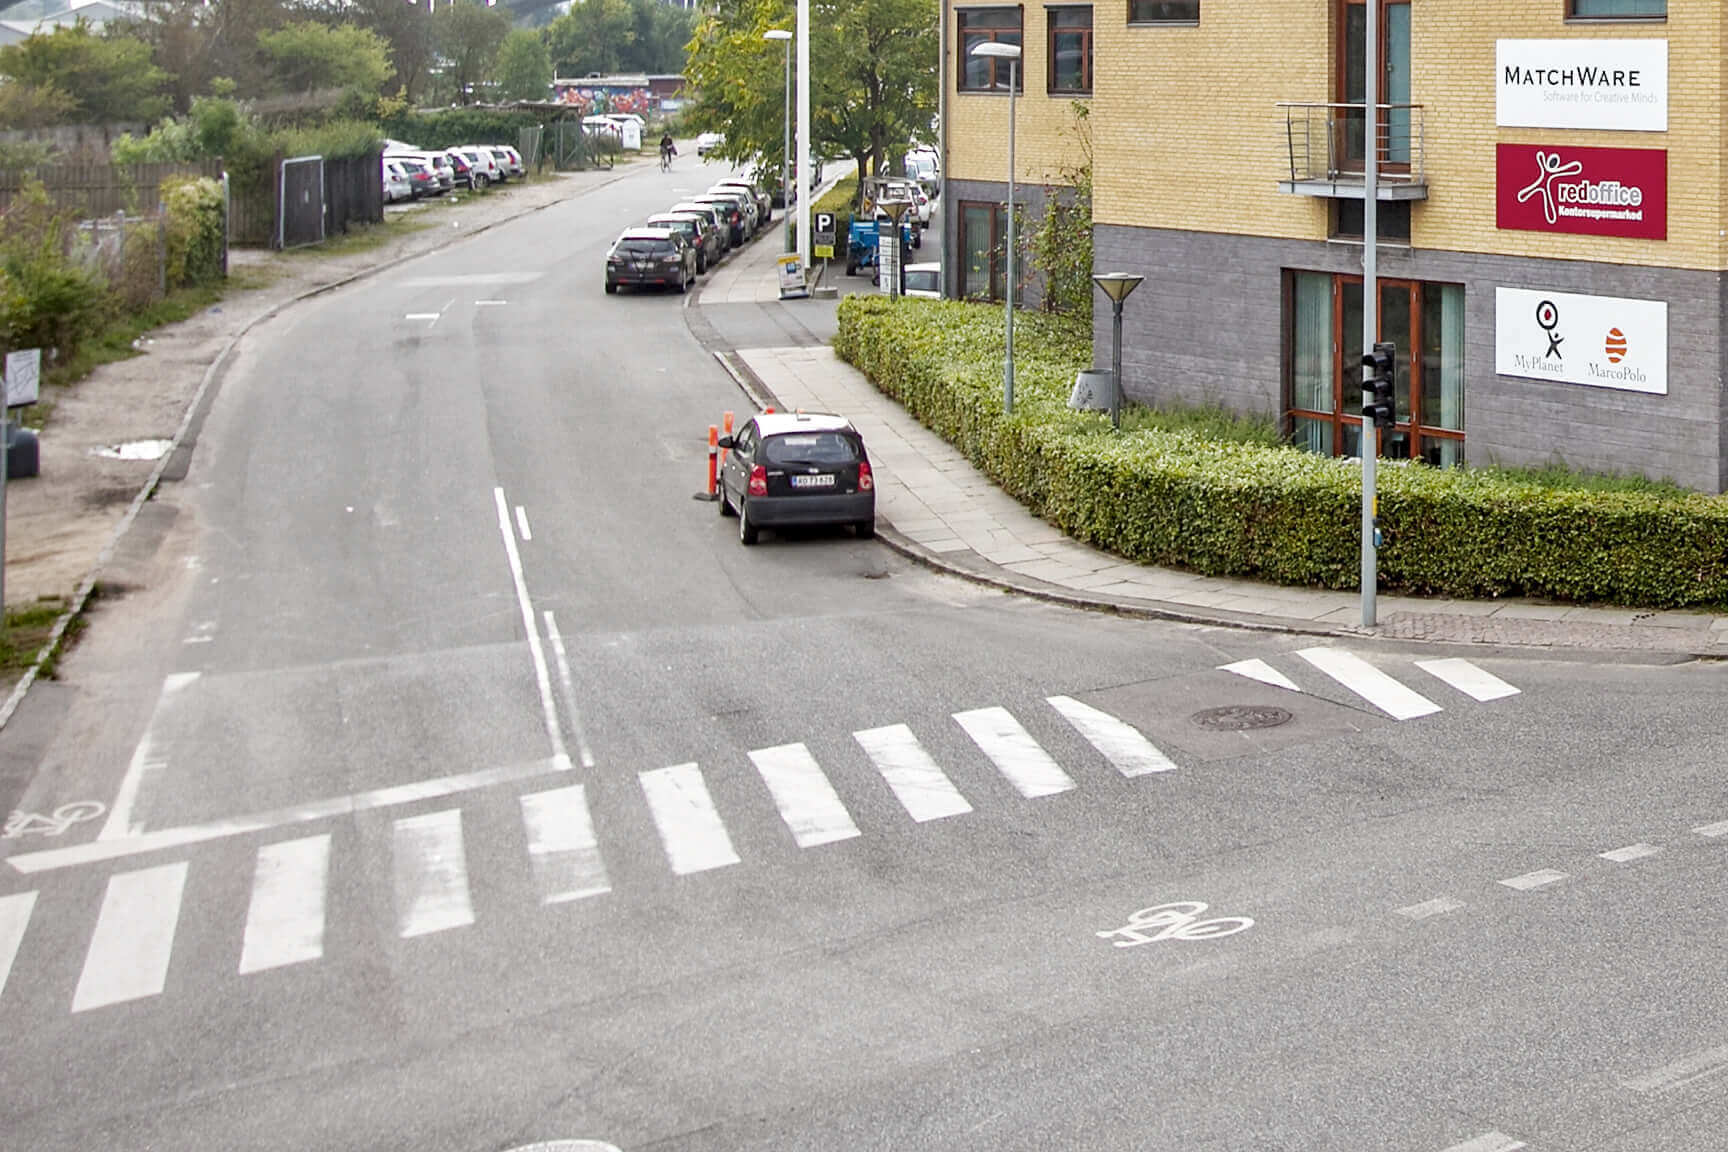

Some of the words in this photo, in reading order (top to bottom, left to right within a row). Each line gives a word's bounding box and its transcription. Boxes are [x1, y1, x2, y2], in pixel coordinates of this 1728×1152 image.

[1594, 91, 1629, 104] Creative
[1631, 92, 1658, 105] Minds
[1558, 180, 1643, 207] redoffice
[818, 214, 832, 232] P
[1514, 354, 1564, 374] MyPlanet
[1588, 363, 1647, 383] MarcoPolo
